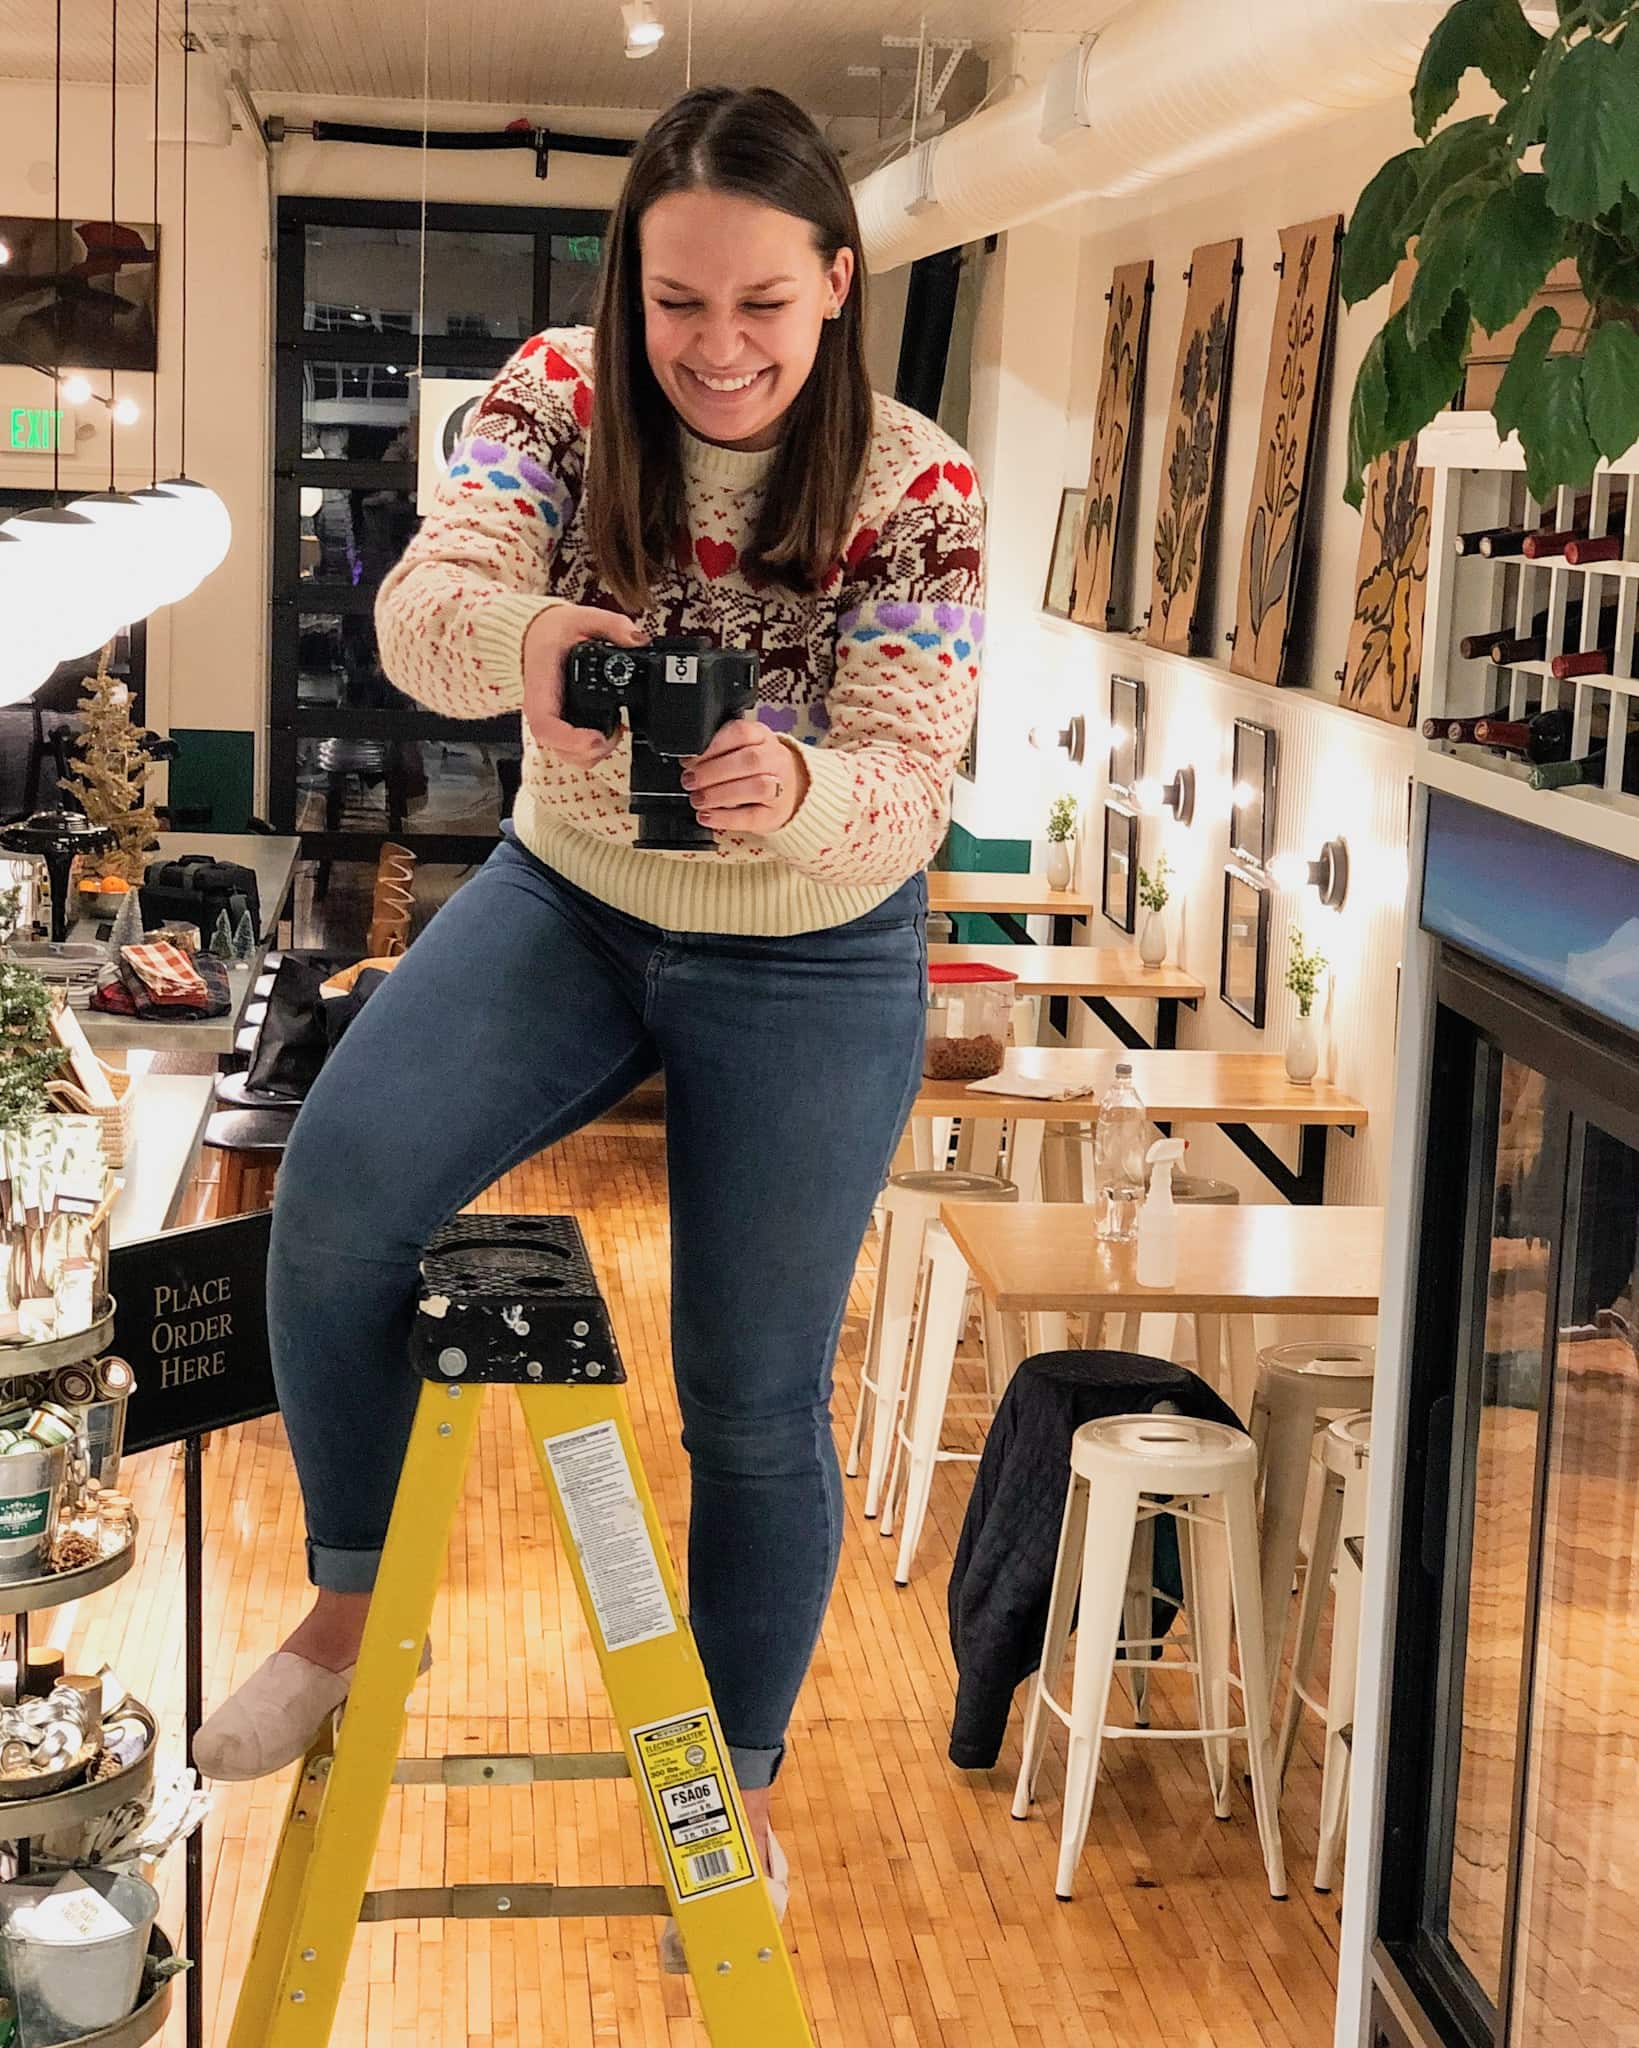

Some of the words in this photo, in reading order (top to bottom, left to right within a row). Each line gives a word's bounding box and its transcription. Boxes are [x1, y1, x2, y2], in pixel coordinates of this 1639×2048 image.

[11, 408, 64, 448] EXIT
[154, 1276, 232, 1318] PLACE
[151, 1313, 233, 1354] ORDER
[160, 1350, 227, 1390] HERE
[671, 1784, 711, 1806] FSA06
